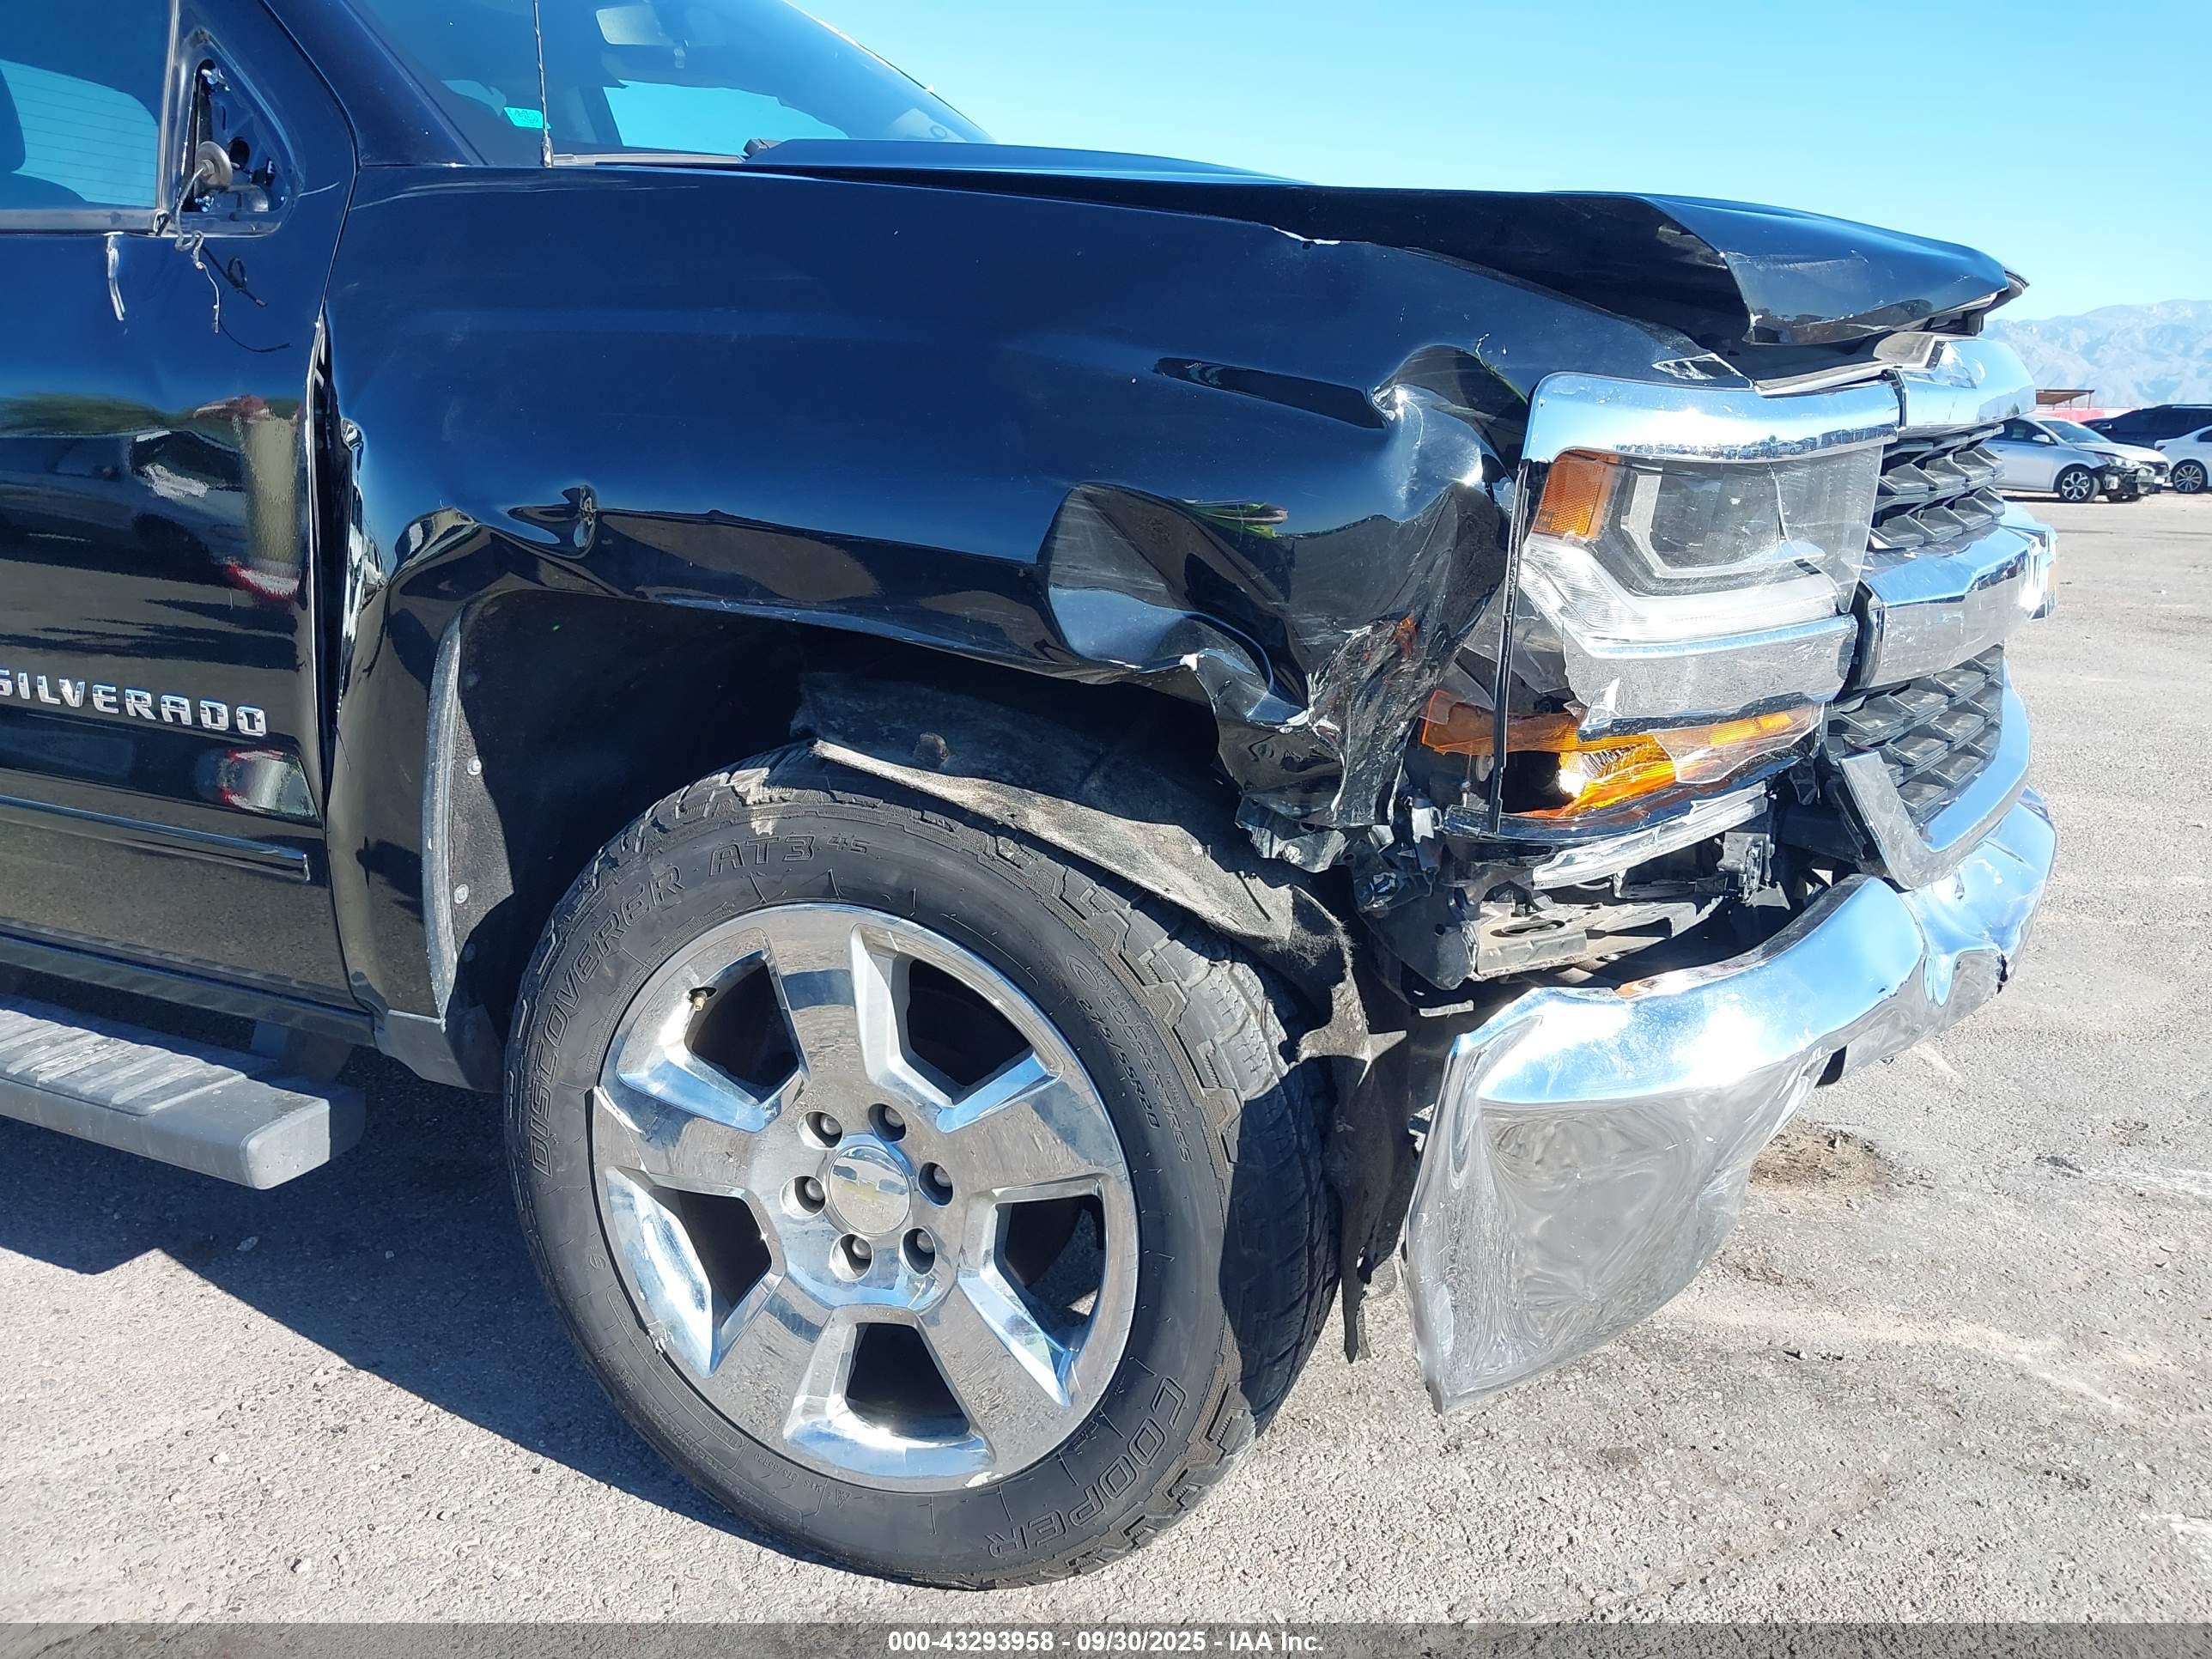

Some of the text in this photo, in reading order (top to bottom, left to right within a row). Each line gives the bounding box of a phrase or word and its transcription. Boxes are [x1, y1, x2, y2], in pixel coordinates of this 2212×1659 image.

[528, 864, 686, 1177] DISCOVERER
[708, 835, 817, 878] AT3
[985, 1376, 1188, 1559] COOPER
